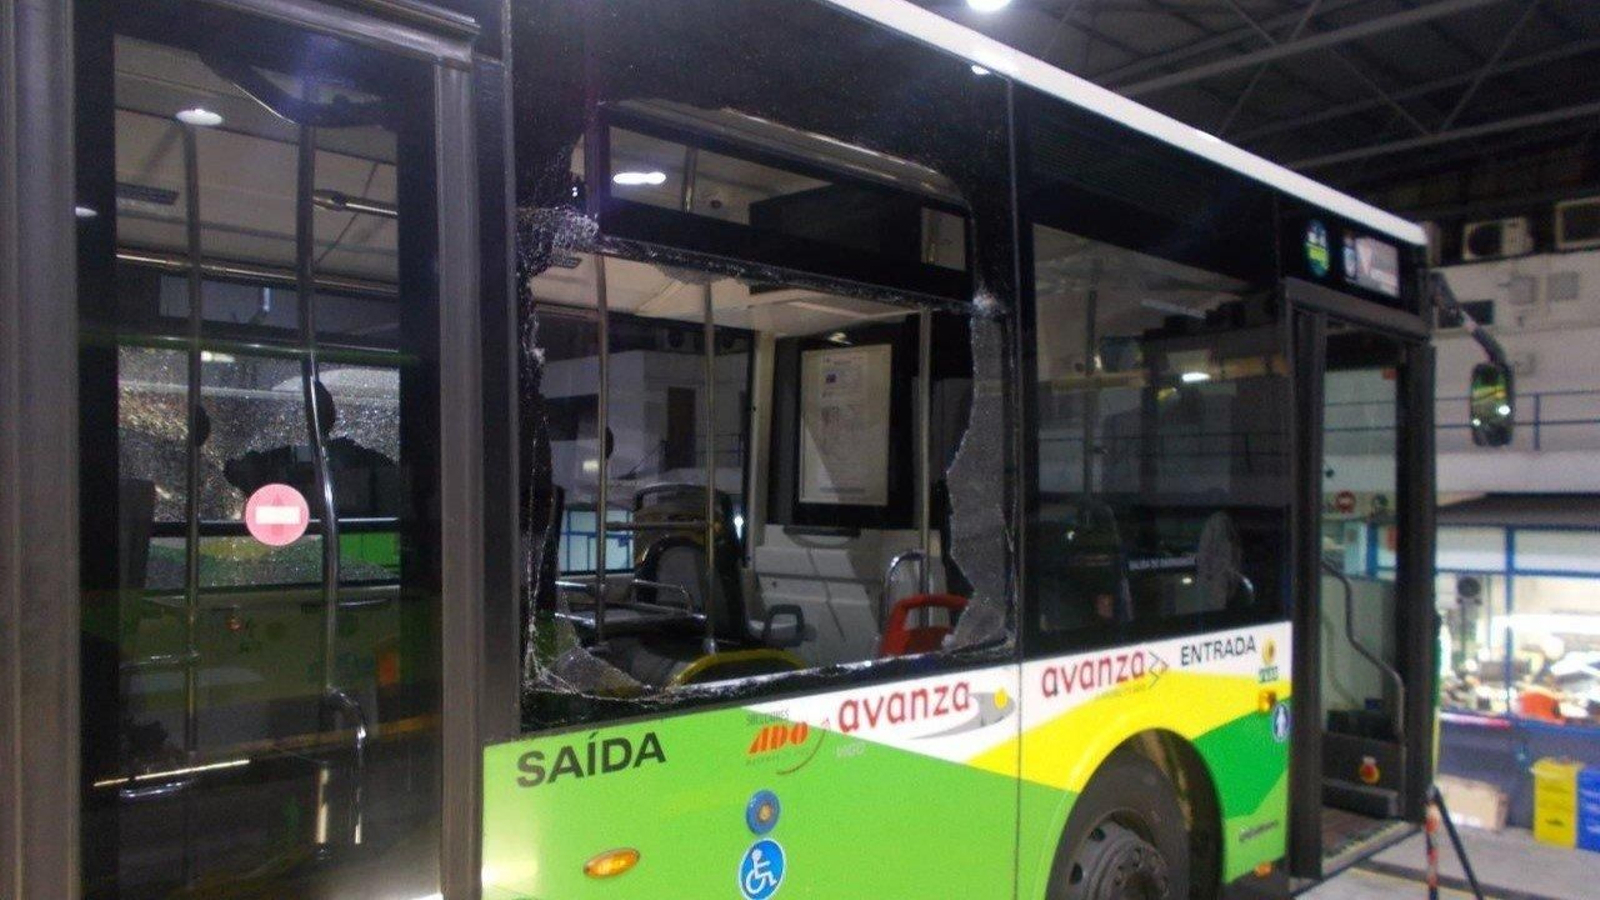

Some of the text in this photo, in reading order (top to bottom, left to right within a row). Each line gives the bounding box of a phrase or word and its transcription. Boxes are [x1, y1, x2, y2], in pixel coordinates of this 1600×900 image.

[1041, 650, 1146, 698] avanza
[1180, 635, 1257, 667] ENTRADA
[837, 681, 971, 734] avanza
[516, 731, 667, 788] SAÍDA
[748, 721, 809, 755] ADO
